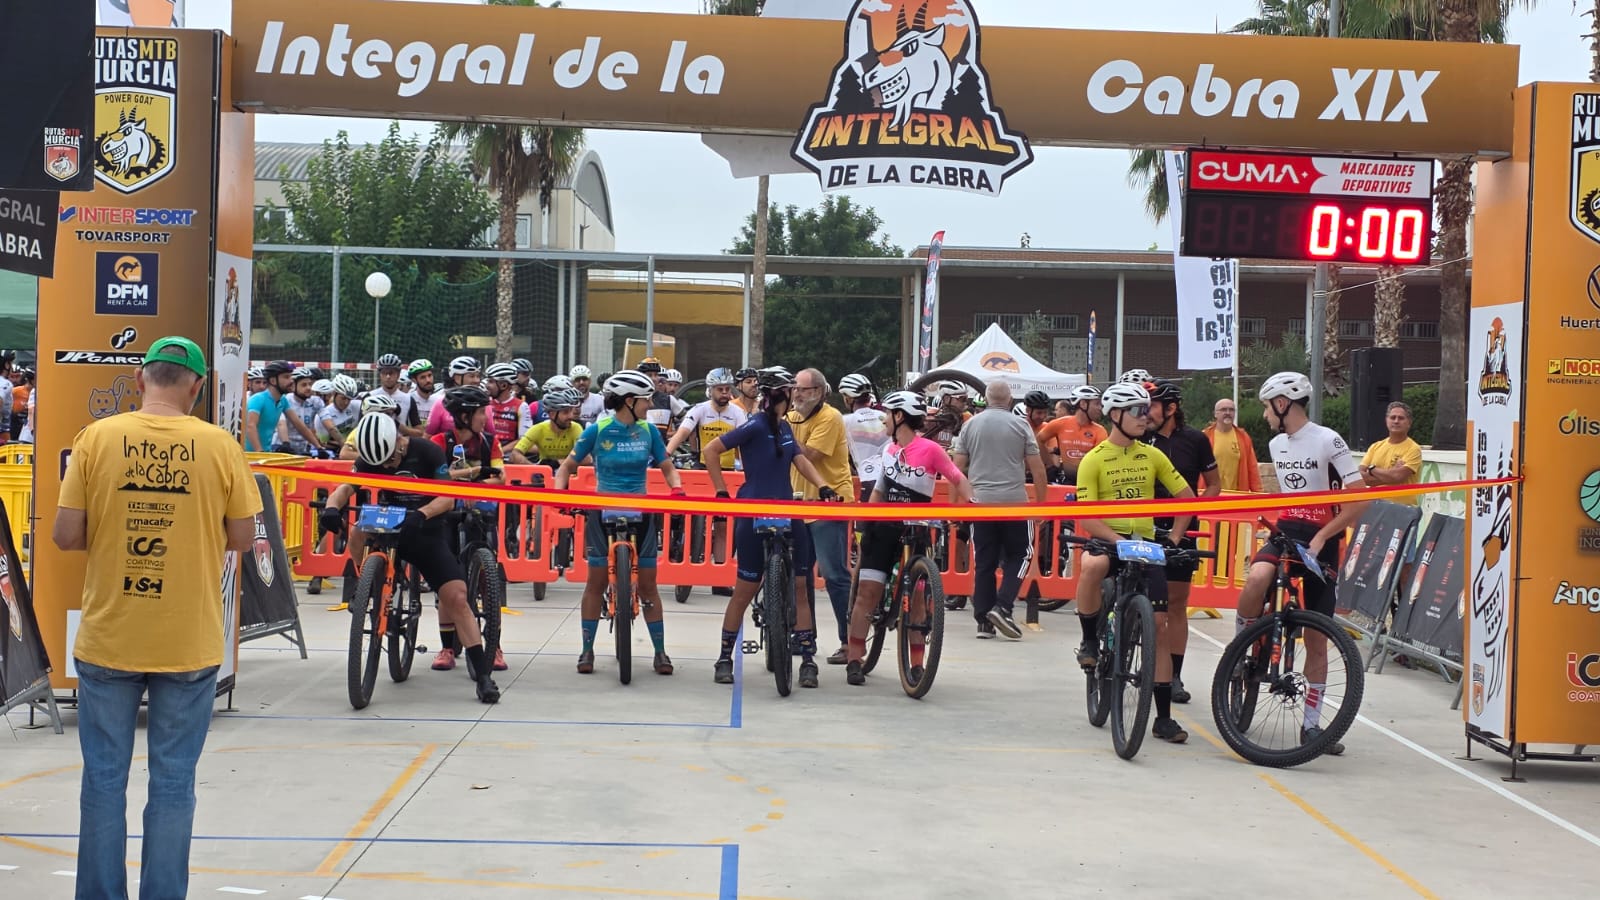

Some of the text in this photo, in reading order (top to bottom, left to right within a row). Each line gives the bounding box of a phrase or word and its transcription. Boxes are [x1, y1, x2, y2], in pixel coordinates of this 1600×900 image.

[255, 21, 725, 97] Integral de la
[105, 93, 154, 105] POWER GOAT
[1086, 59, 1441, 123] Cabra XIX
[1574, 94, 1600, 115] RU
[44, 135, 80, 146] MURCIA
[809, 112, 1015, 154] INTEGRAL
[827, 164, 994, 193] DE LA CABRA
[1198, 160, 1300, 184] CUMA
[1339, 162, 1416, 177] MARCADORES
[1341, 178, 1412, 194] DEPORTIVOS
[78, 207, 194, 225] INTERSPORT
[76, 230, 170, 243] TOVARSPORT
[1308, 205, 1424, 260] 0:00
[107, 283, 149, 300] DFM
[122, 434, 195, 468] Integral
[146, 463, 190, 485] Cabra
[133, 518, 174, 527] macafer
[126, 558, 165, 567] COATINGS
